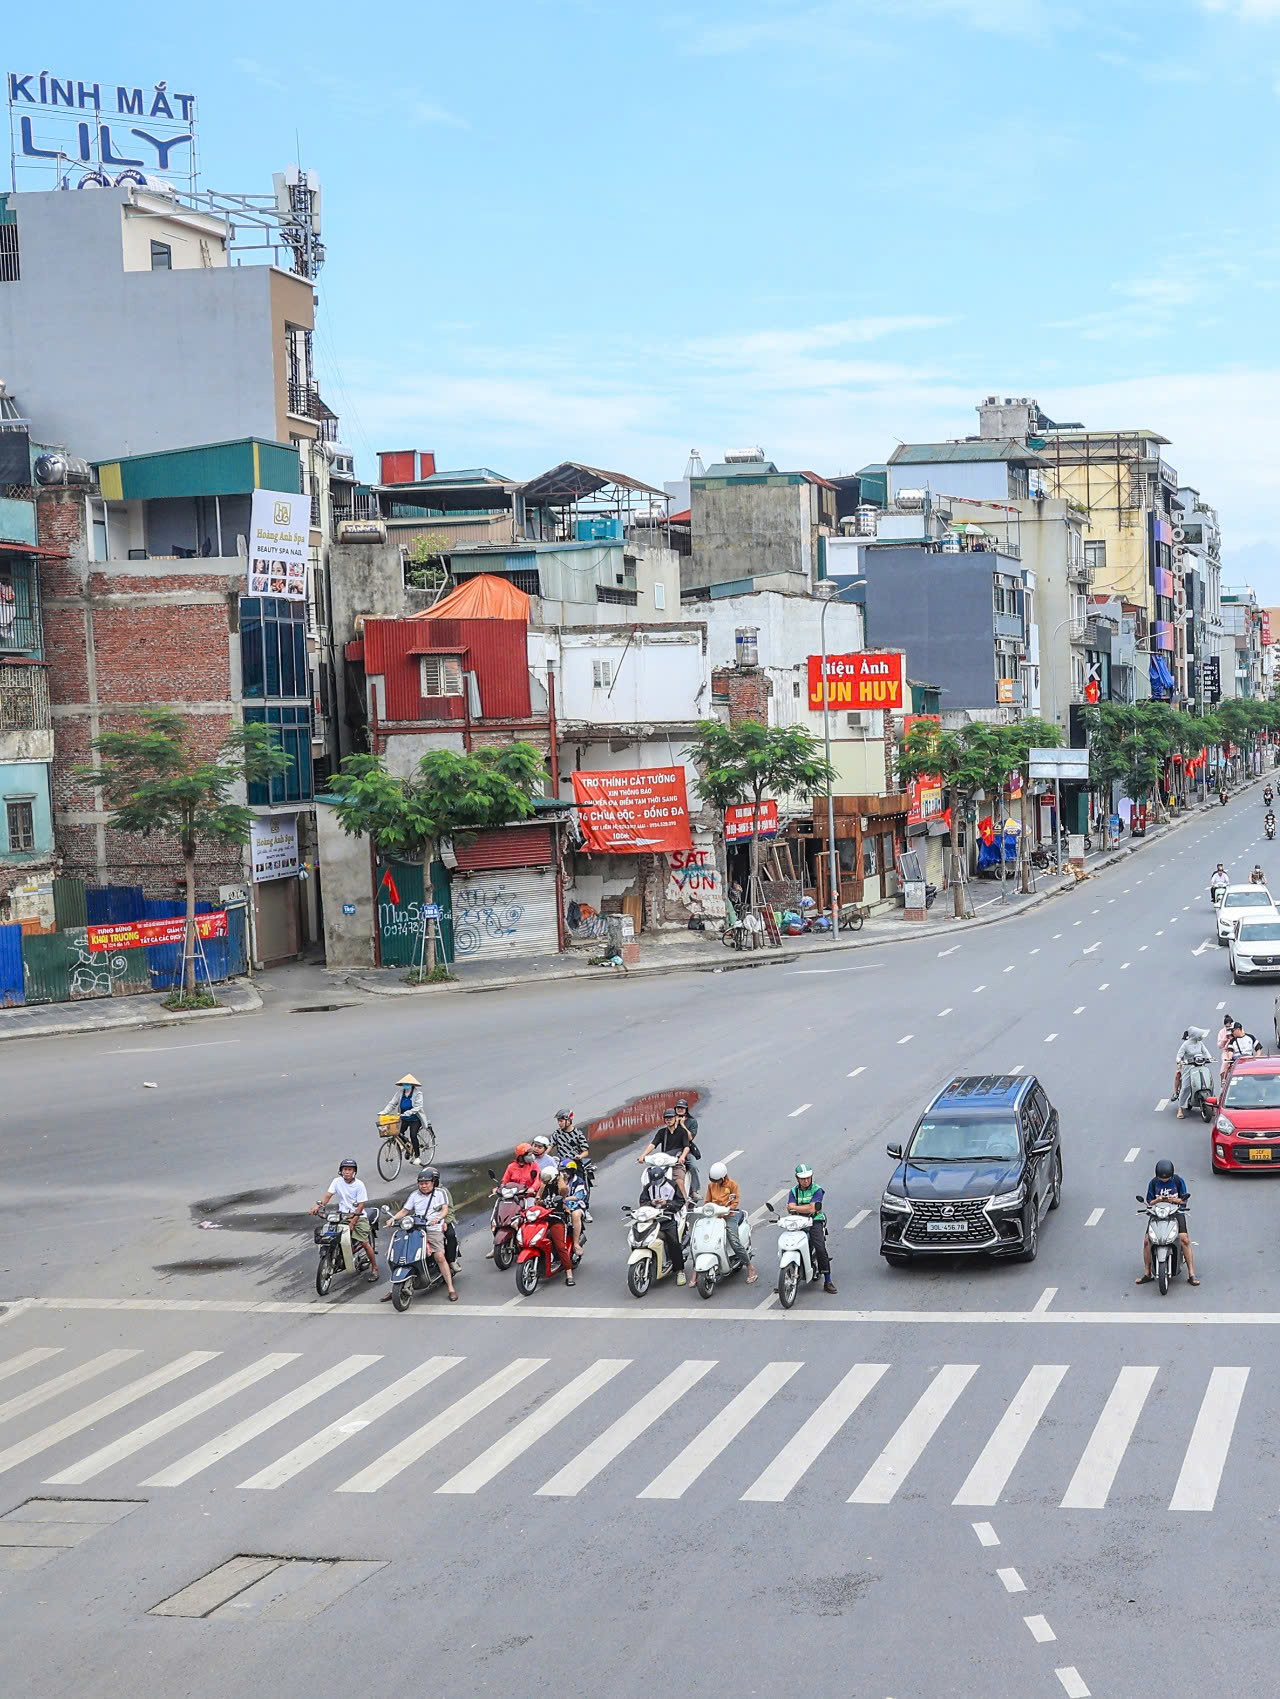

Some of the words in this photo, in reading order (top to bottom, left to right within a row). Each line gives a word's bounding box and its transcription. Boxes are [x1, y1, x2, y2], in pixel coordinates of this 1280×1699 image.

[10, 70, 100, 110] KÍNH
[117, 80, 195, 120] MẮT
[20, 115, 194, 170] LILY
[280, 531, 293, 542] Anh
[294, 533, 305, 545] Spa
[257, 546, 278, 554] BEAUTY
[279, 547, 289, 555] SPA
[290, 548, 303, 556] NAIL
[821, 660, 855, 678] Hiệu
[860, 658, 889, 674] Ảnh
[810, 681, 852, 702] JUN
[859, 680, 899, 702] HUY
[582, 777, 599, 790] TRỢ
[600, 776, 628, 787] THÍNH
[630, 775, 646, 786] CÁT
[647, 773, 676, 784] TƯỜNG
[640, 787, 652, 795] BÁO
[644, 805, 669, 818] ĐỐNG
[671, 806, 684, 816] ĐA
